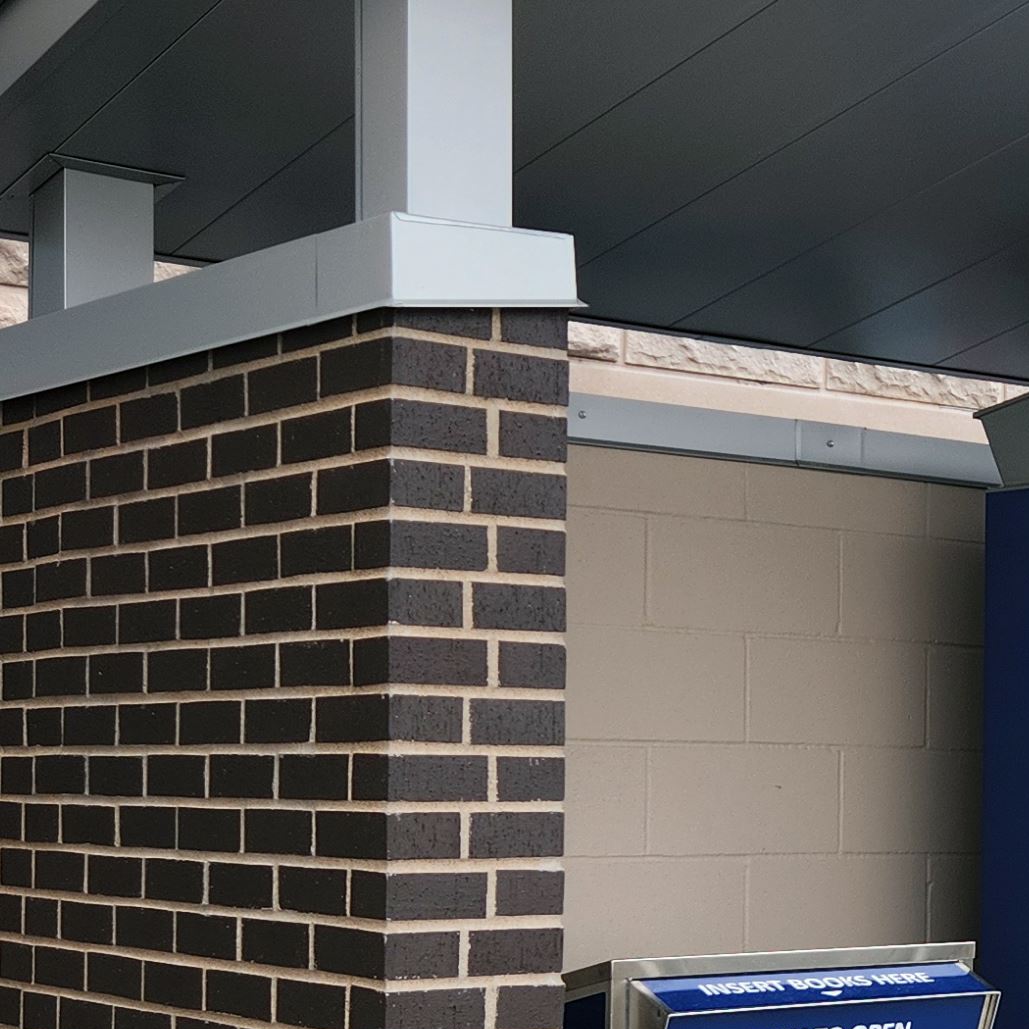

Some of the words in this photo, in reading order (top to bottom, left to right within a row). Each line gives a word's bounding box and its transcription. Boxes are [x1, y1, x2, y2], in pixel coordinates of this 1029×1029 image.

[699, 979, 786, 997] INSERT
[788, 973, 874, 990] BOOKS
[877, 971, 935, 985] HERE
